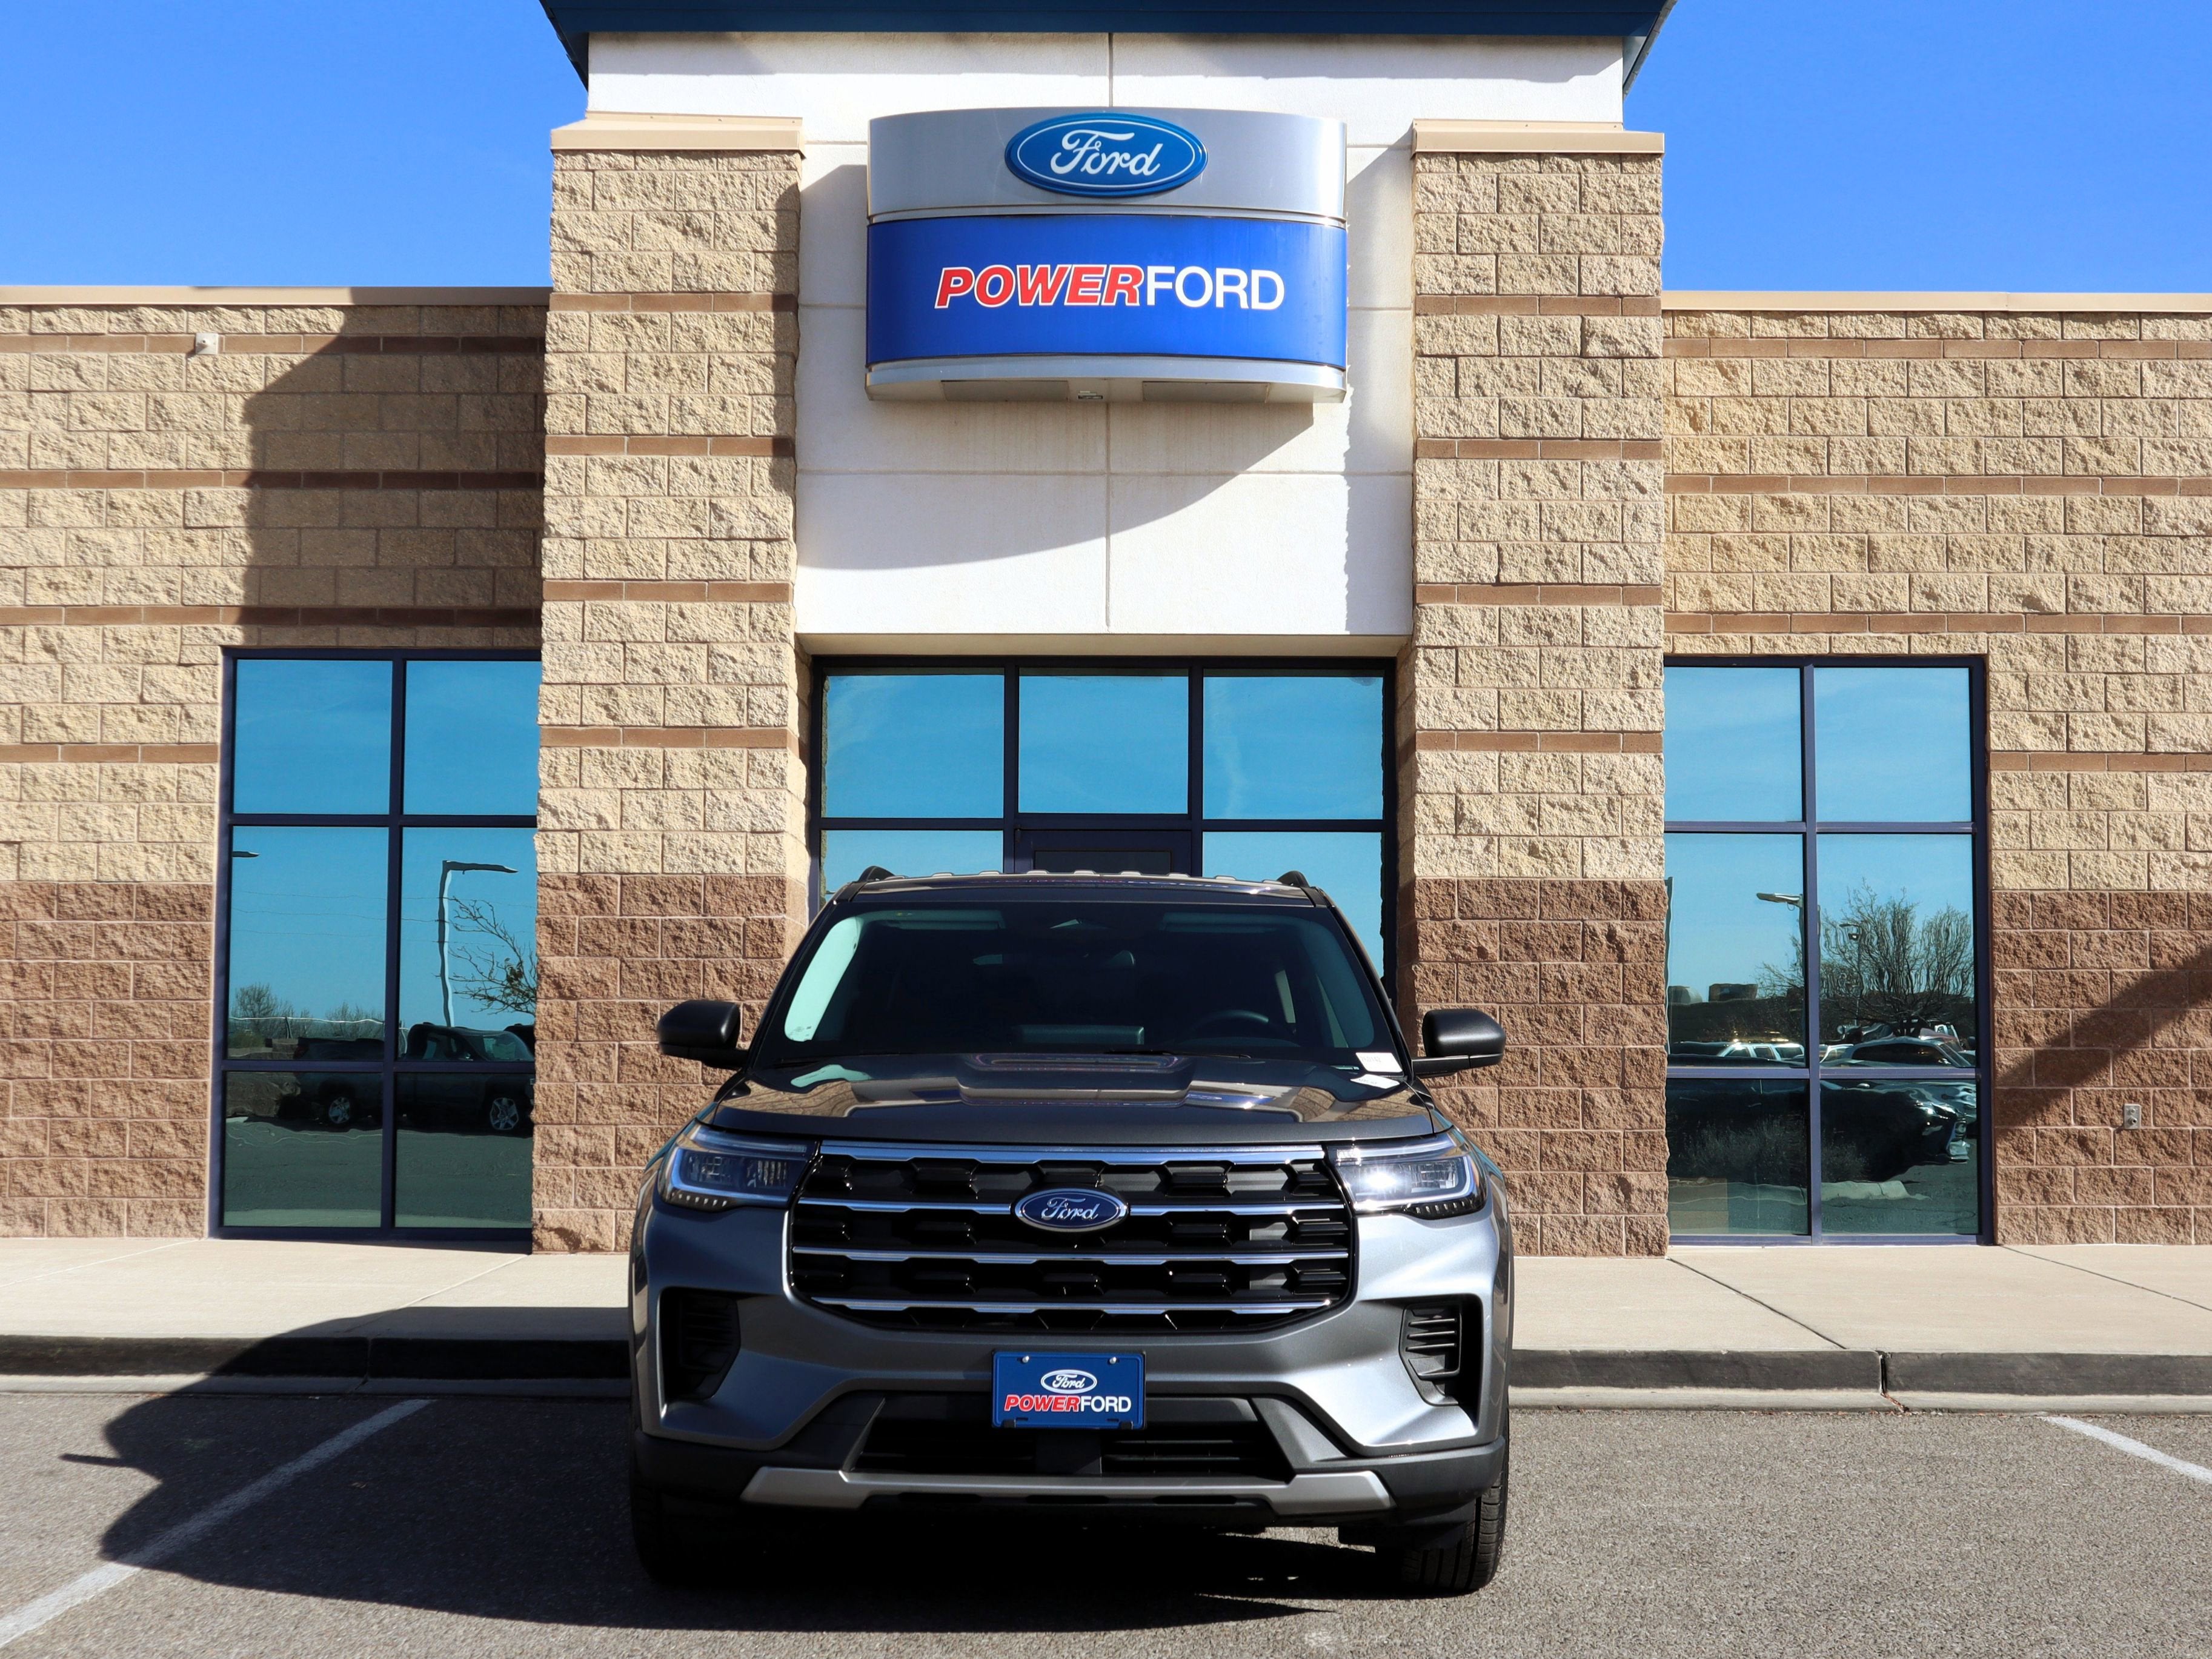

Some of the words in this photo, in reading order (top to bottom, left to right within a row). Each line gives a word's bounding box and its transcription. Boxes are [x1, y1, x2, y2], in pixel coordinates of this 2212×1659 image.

[1051, 129, 1163, 176] Ford
[1041, 1197, 1100, 1220] Ford
[1052, 1374, 1086, 1389] Ford
